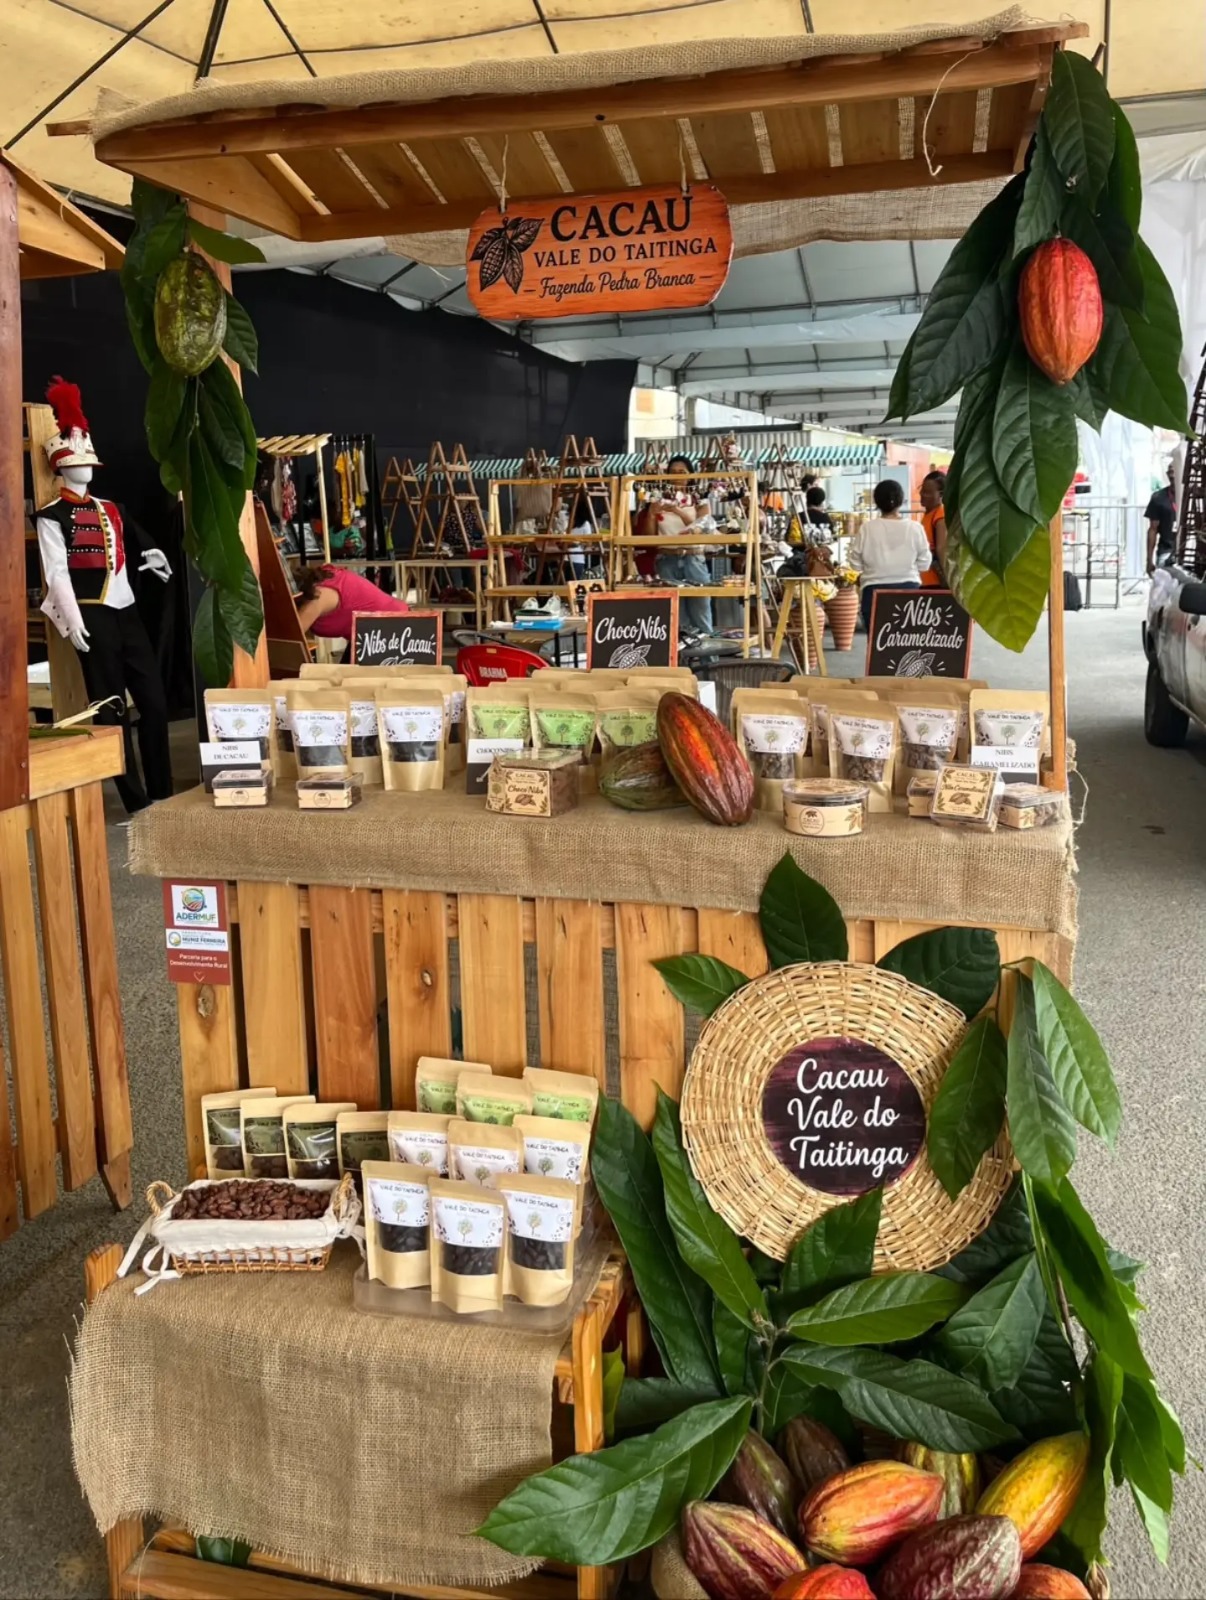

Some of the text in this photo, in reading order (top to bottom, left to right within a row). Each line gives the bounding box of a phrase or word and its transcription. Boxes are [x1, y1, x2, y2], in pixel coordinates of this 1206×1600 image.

[550, 196, 693, 242] CACAU
[534, 237, 717, 267] VALE DO TAITINGA
[539, 267, 695, 302] Fazenda Pedra Branca
[901, 596, 942, 629] Nibs
[357, 630, 387, 662] Nibs
[387, 631, 400, 651] de
[594, 616, 668, 644] Choco'Nibs
[876, 622, 965, 652] Caramelizado
[479, 666, 508, 679] BRAHMA
[176, 912, 216, 921] ADERMUF
[796, 1058, 889, 1094] Cacau
[787, 1095, 899, 1130] Vale do
[789, 1135, 908, 1178] Taitinga
